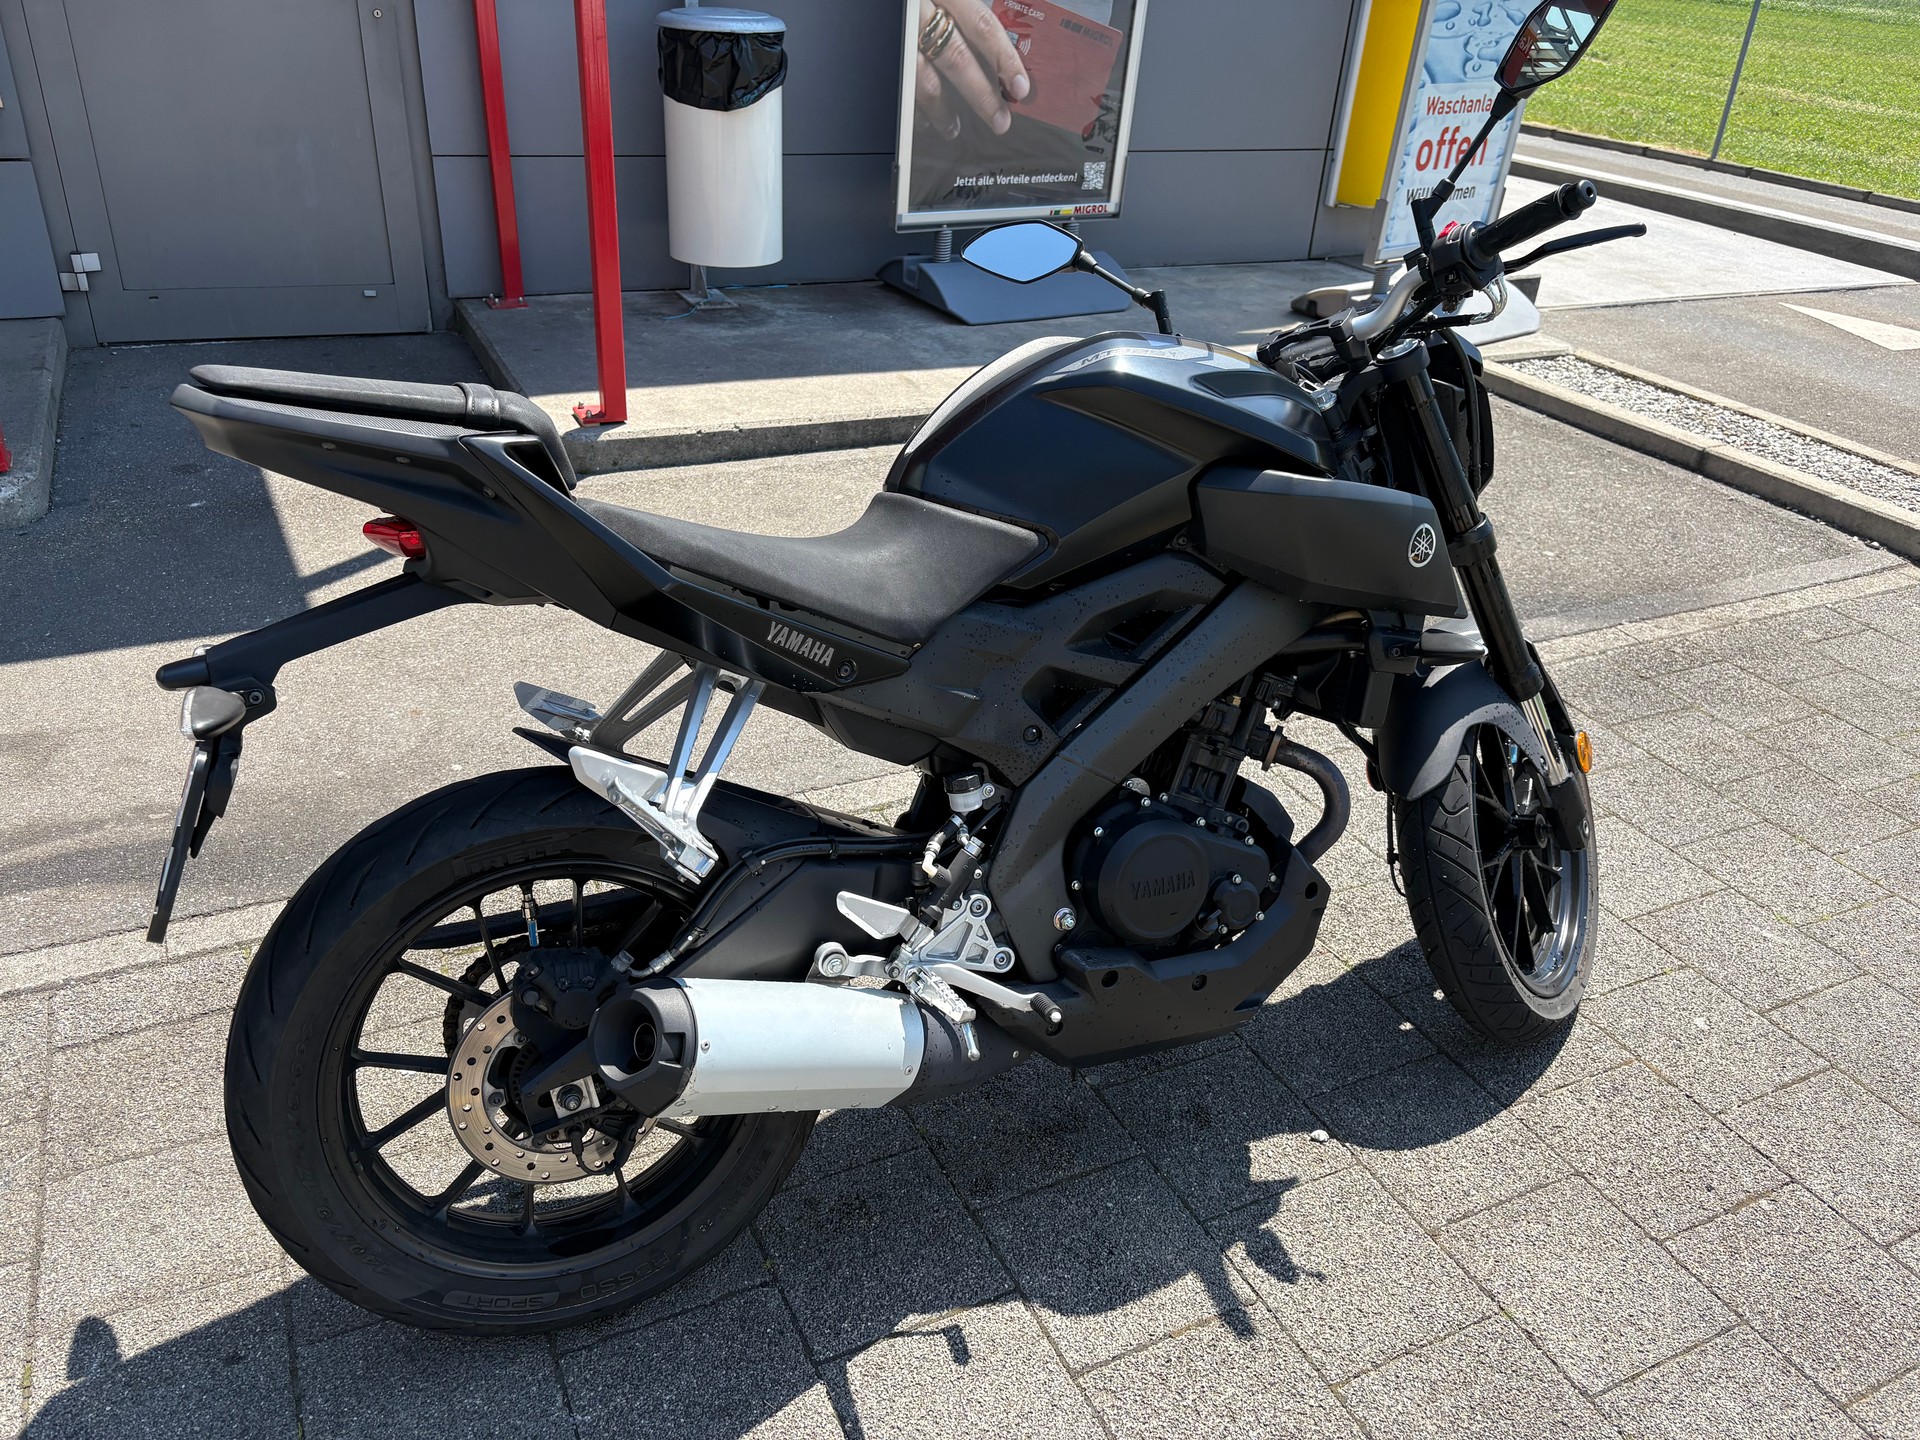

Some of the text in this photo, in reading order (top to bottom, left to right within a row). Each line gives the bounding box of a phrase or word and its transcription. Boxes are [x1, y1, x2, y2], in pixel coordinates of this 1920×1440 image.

[1004, 0, 1045, 20] PRIVATE CARD
[1426, 94, 1493, 116] Waschanla
[1415, 126, 1488, 172] offen
[953, 172, 1078, 187] Jetzt alle Vorteile entdecken!
[1073, 204, 1108, 215] MIGROL
[766, 620, 835, 668] YAMAHA
[1130, 870, 1196, 901] YAMAHA
[460, 1252, 671, 1310] ROSSO SPORT
